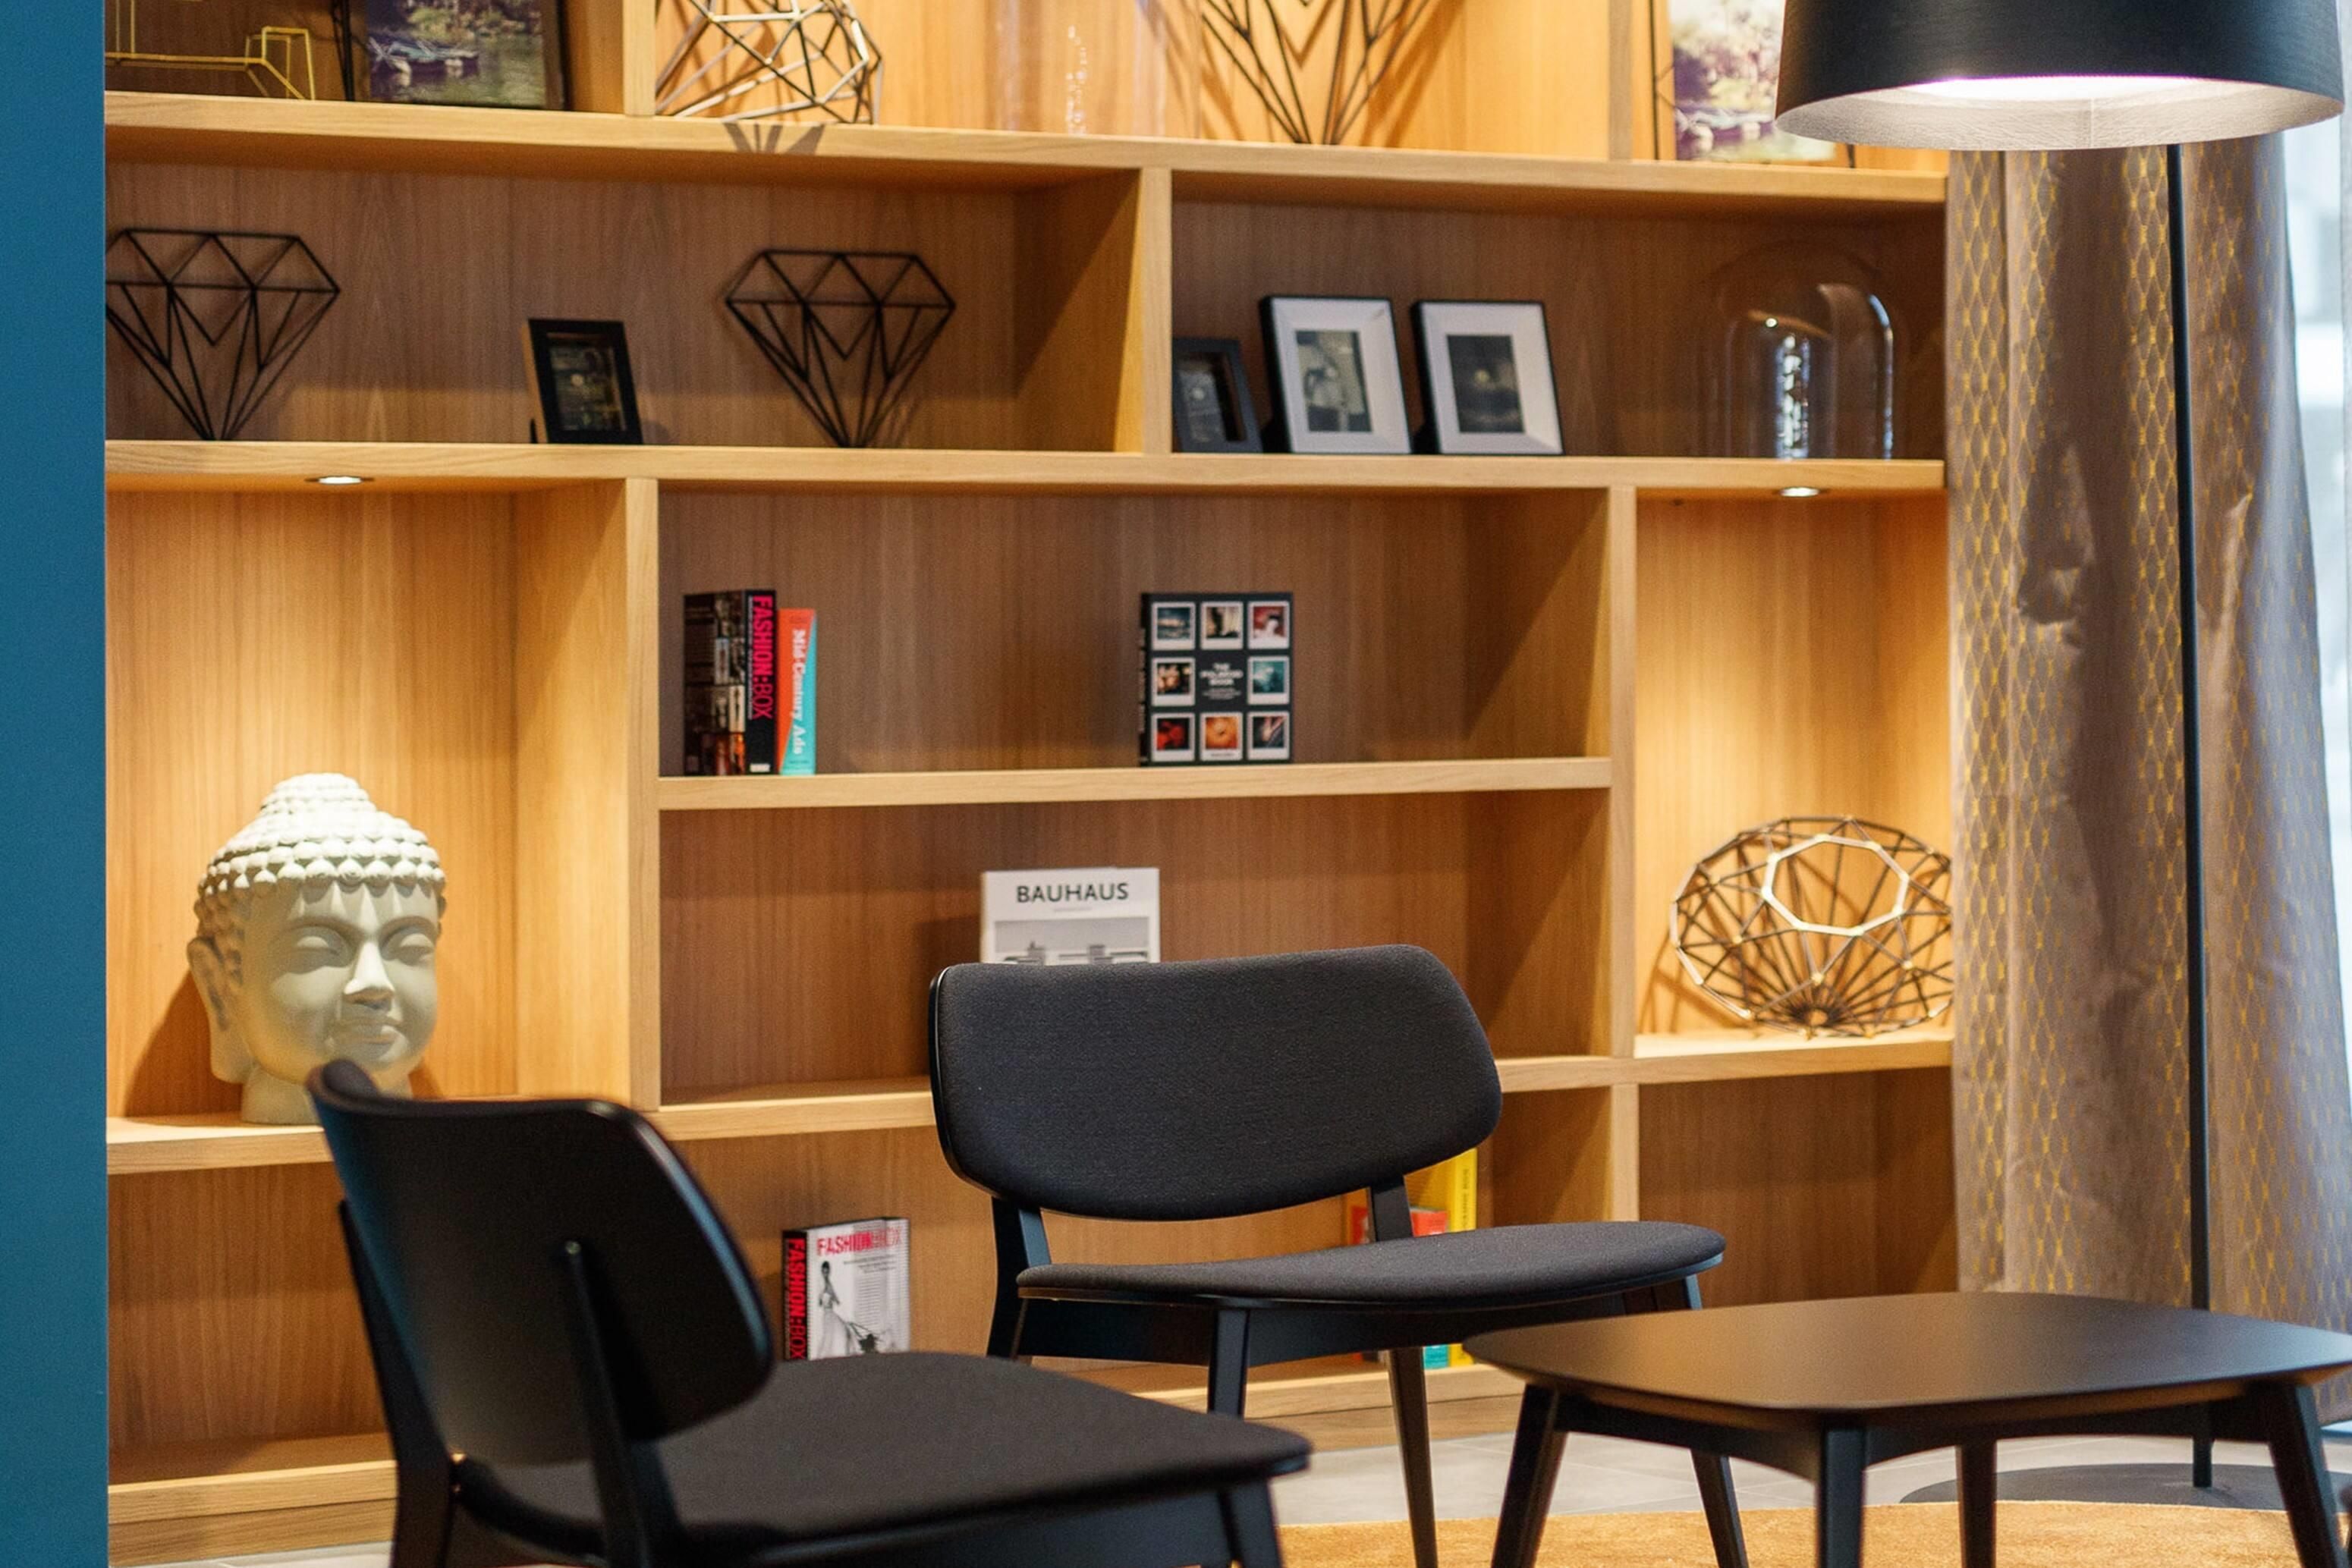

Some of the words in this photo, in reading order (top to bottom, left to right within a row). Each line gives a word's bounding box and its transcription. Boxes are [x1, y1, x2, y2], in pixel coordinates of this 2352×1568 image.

[752, 595, 774, 720] FASHION:BOX
[792, 724, 807, 754] Ads
[1016, 883, 1130, 903] BAUHAUS
